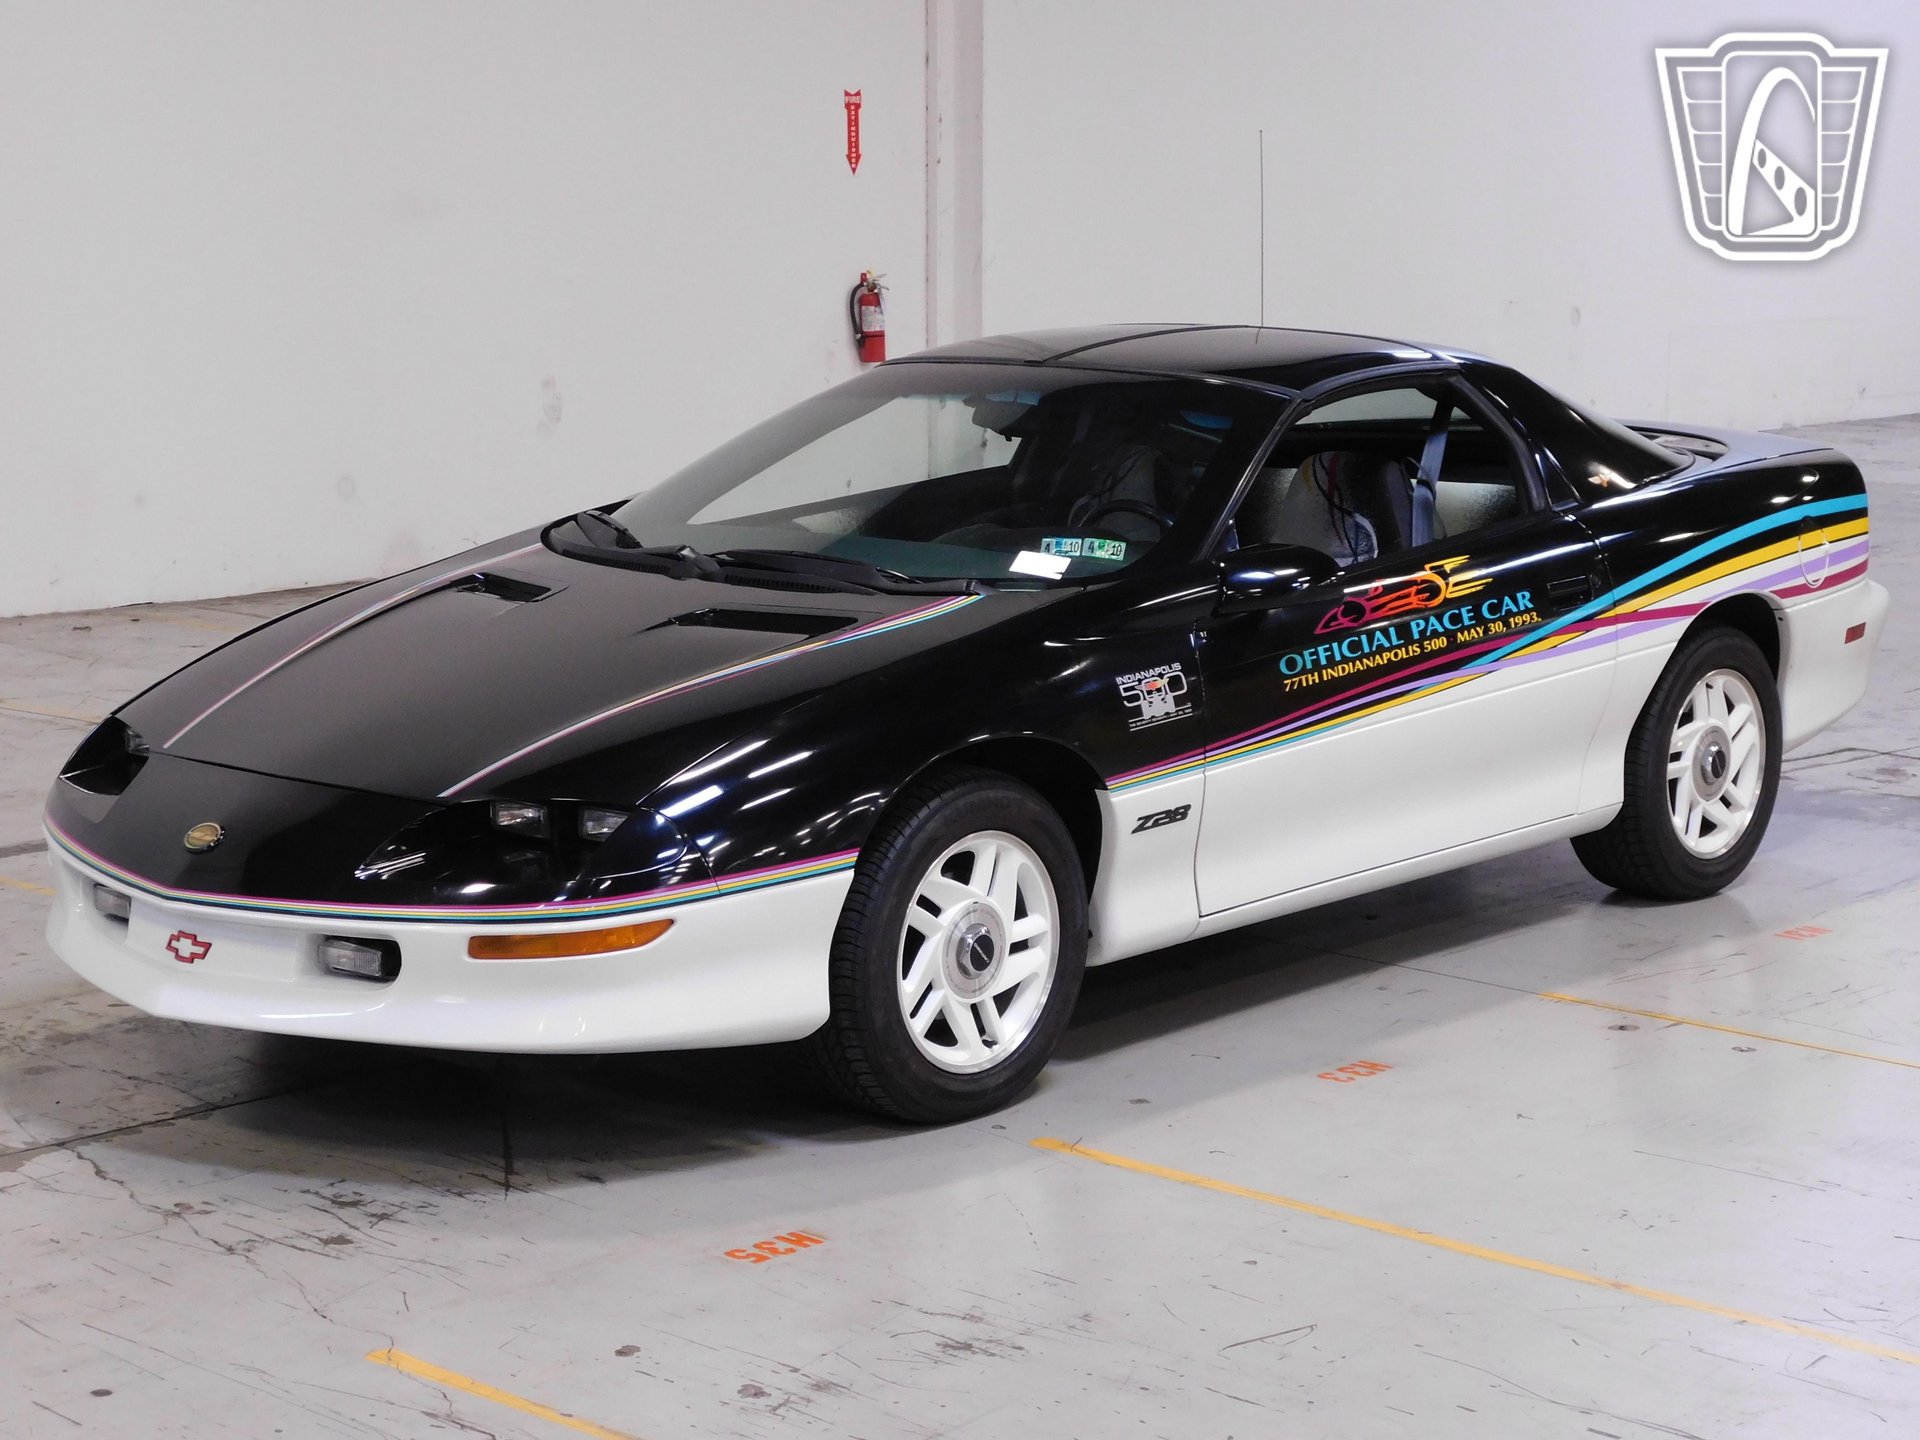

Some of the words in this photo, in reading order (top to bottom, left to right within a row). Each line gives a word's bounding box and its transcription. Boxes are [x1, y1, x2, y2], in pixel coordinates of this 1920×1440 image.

[1279, 628, 1405, 676] OFFICIAL
[1409, 606, 1476, 640] PACE
[1480, 590, 1534, 620] CAR
[1284, 670, 1320, 692] 77TH
[1322, 644, 1421, 681] INDIANAPOLIS
[1423, 636, 1448, 654] 500
[1456, 625, 1486, 644] MAY
[1487, 621, 1507, 634] 30,
[1508, 611, 1542, 630] 1993.
[1115, 663, 1182, 685] INDIANAPOLIS
[1119, 671, 1188, 707] 500
[1131, 803, 1192, 835] Z28
